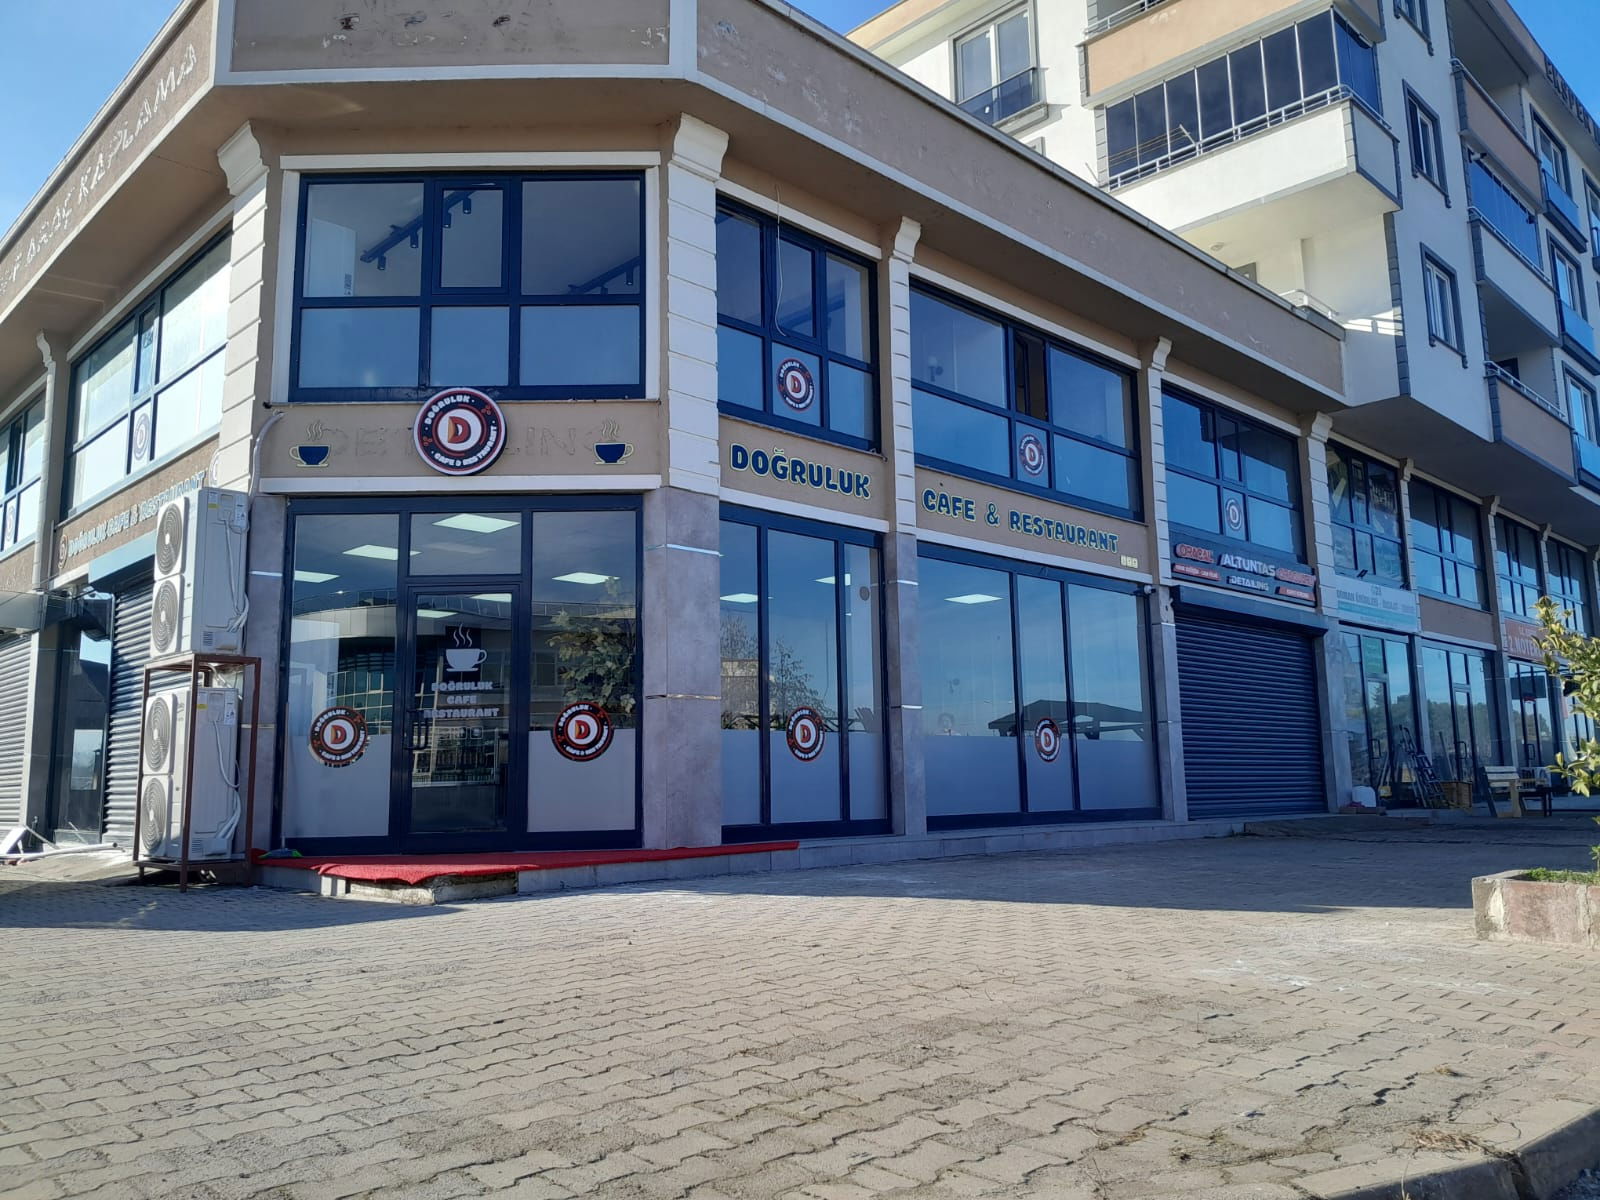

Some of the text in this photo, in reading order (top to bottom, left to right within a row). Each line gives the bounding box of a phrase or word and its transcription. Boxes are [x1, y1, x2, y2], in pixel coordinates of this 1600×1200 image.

[447, 415, 472, 444] D
[730, 443, 871, 500] DOĞRULUK
[922, 487, 1120, 553] CAFE & RESTAURANT
[431, 681, 494, 691] DOĞRULUK
[446, 695, 477, 705] CAFE
[423, 707, 500, 718] RESTAURANT
[330, 724, 347, 744] D
[575, 719, 591, 739] D
